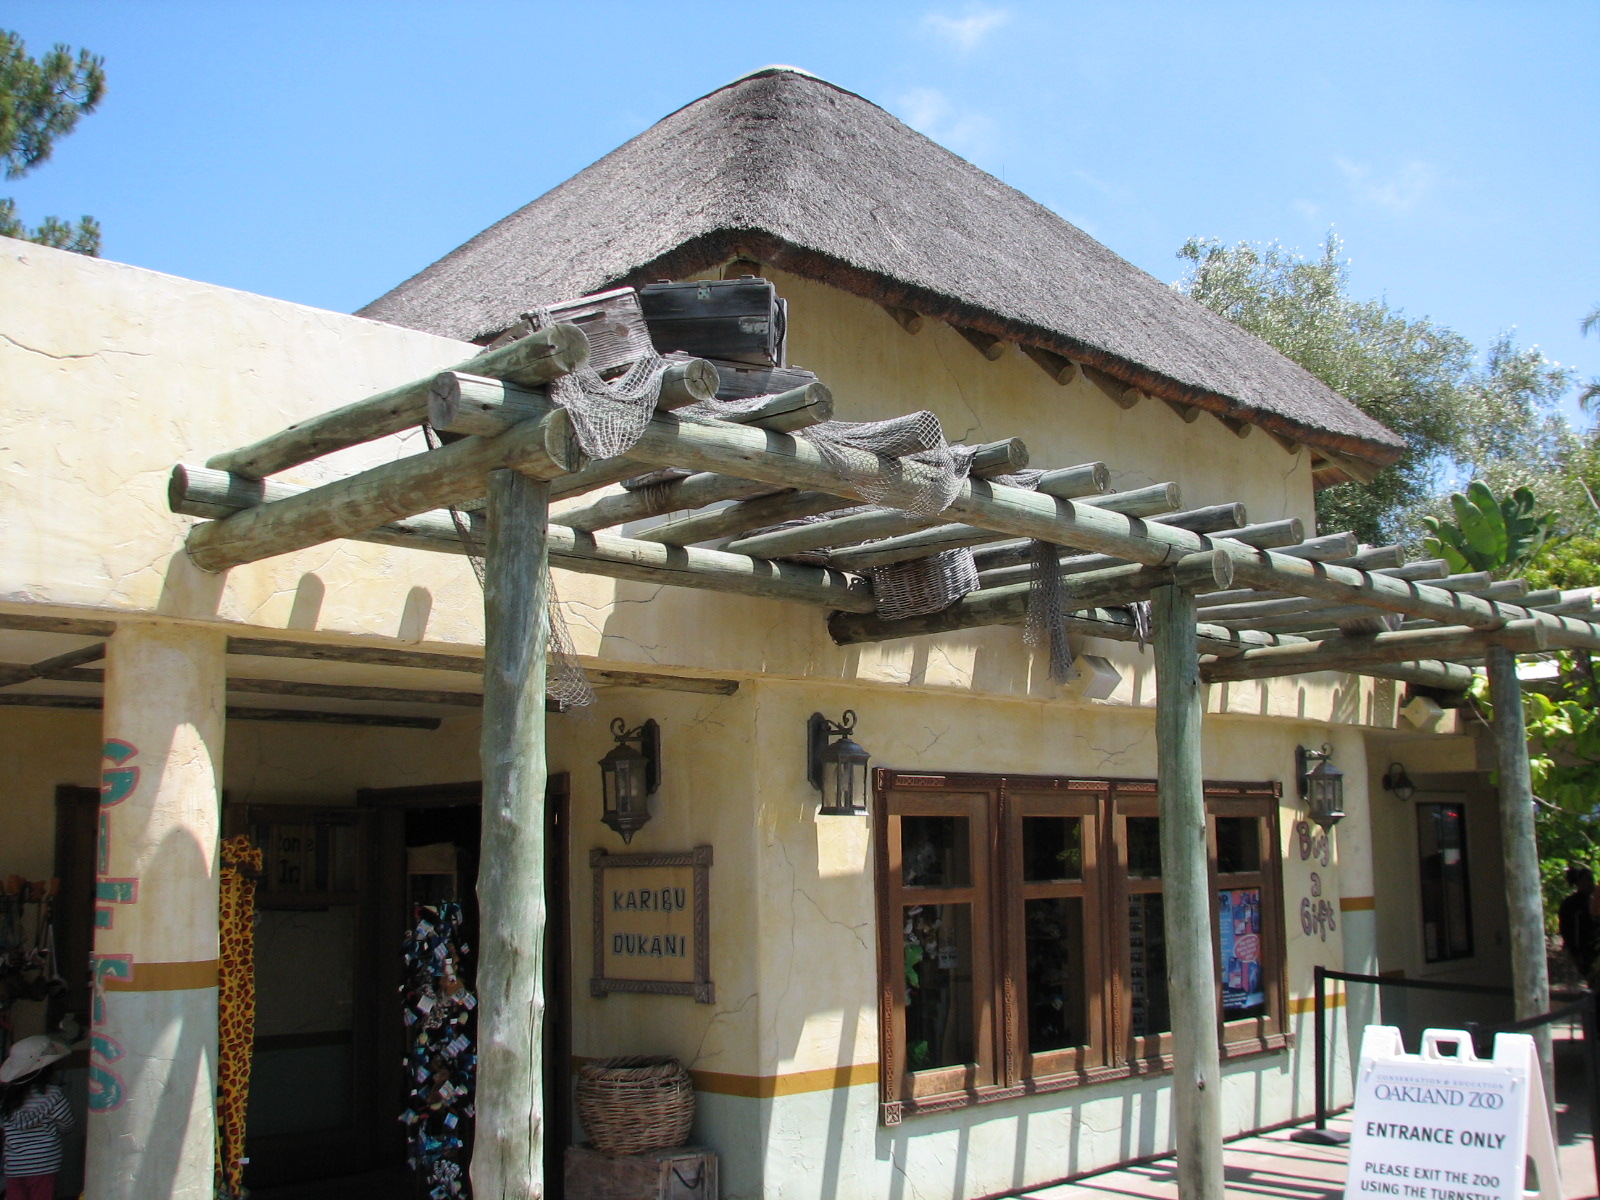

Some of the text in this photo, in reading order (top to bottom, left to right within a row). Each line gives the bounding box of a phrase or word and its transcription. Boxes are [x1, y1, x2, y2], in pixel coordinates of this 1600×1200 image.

[1297, 821, 1330, 867] Buy
[1310, 872, 1321, 897] a
[613, 886, 686, 913] KARIBU
[1300, 897, 1336, 942] Gift
[613, 931, 686, 958] DUKANI
[1374, 1084, 1504, 1110] OAKLAND ZOO
[1366, 1121, 1507, 1149] ENTRANCE ONLY
[1365, 1161, 1500, 1188] PLEASE EXIT THE ZOO
[1361, 1180, 1399, 1195] USING
[1403, 1184, 1427, 1199] THE
